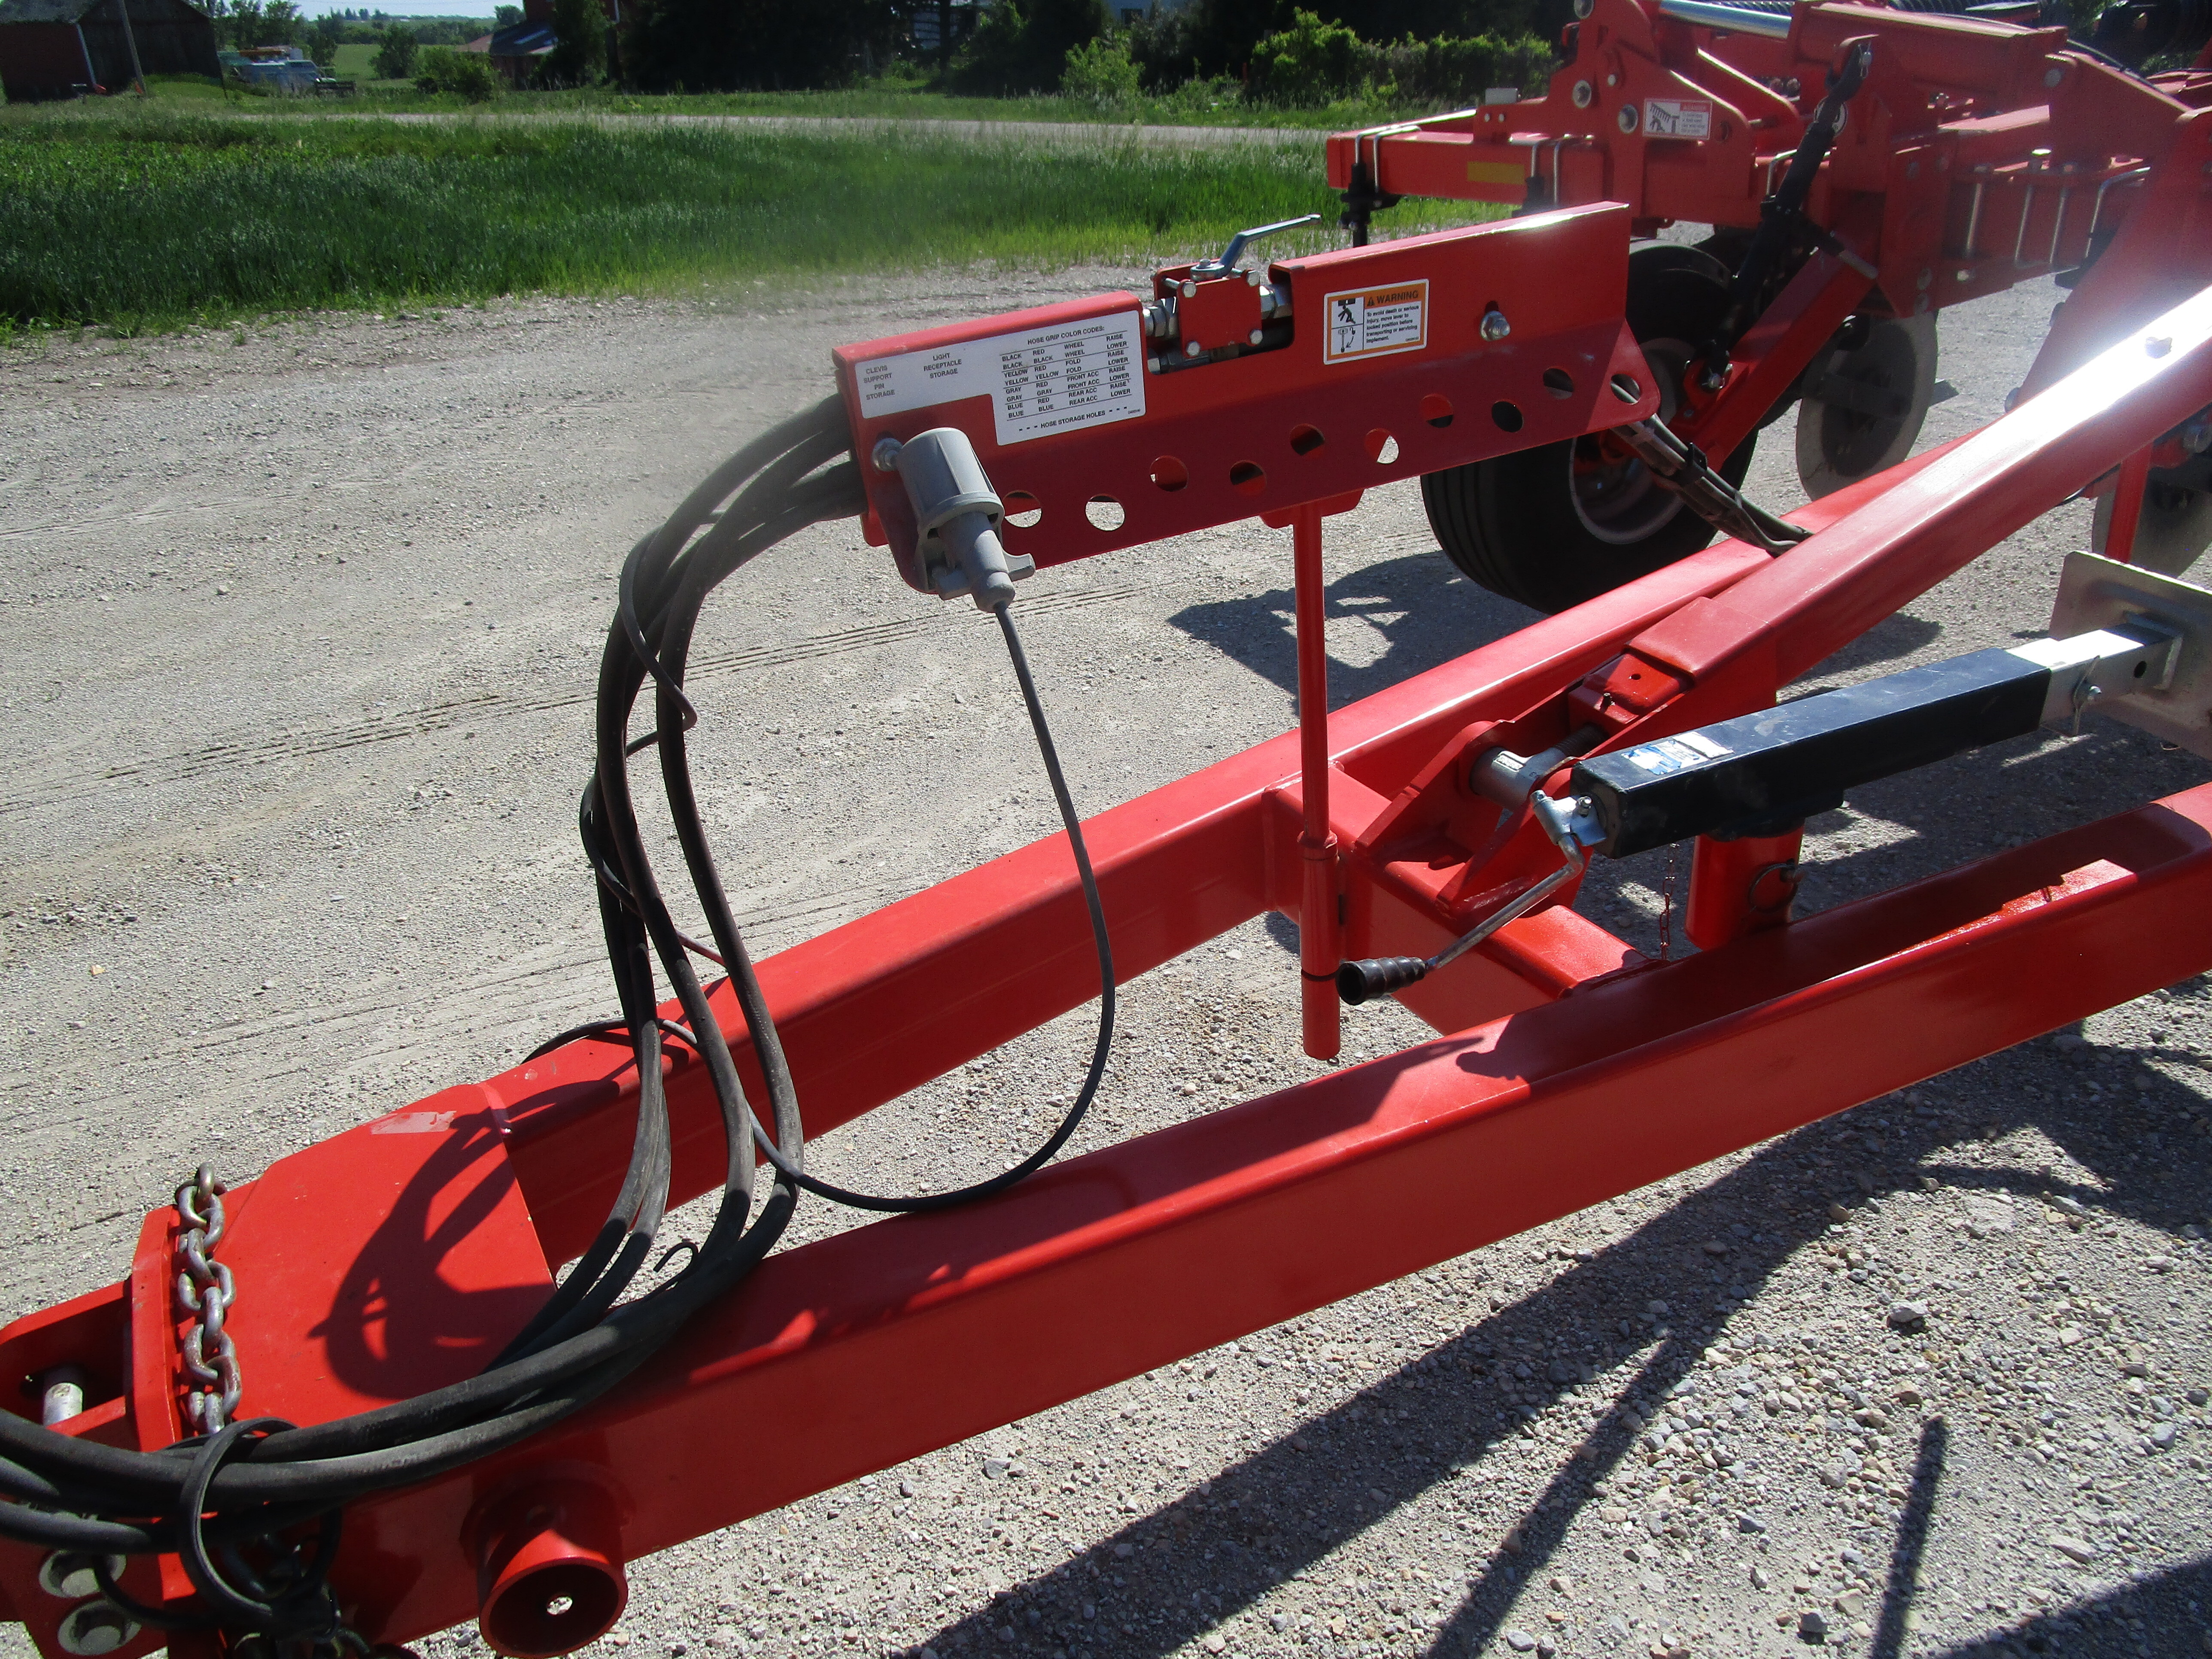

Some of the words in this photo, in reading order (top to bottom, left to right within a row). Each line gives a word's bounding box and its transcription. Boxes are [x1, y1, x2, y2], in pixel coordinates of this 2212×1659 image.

[1376, 290, 1419, 304] WARNING
[1083, 326, 1105, 334] CODES:
[1366, 328, 1392, 336] transporting
[933, 352, 950, 361] LIGHT
[1002, 353, 1022, 362] BLACK
[1063, 341, 1084, 349] WHEEL
[1003, 361, 1023, 370] BLACK
[1107, 341, 1127, 349] LOWER
[866, 365, 888, 374] CLEVIS
[924, 359, 962, 371] RECEPTACLE
[863, 373, 892, 383] SUPPORT
[930, 368, 958, 379] STORAGE
[1004, 369, 1028, 377] YELLOW
[1005, 377, 1029, 386] YELLOW
[1035, 371, 1059, 380] YELLOW
[866, 389, 895, 400] STORAGE
[1111, 389, 1130, 397] LOWER
[1058, 415, 1085, 425] STORAGE
[1086, 410, 1106, 420] HOLES
